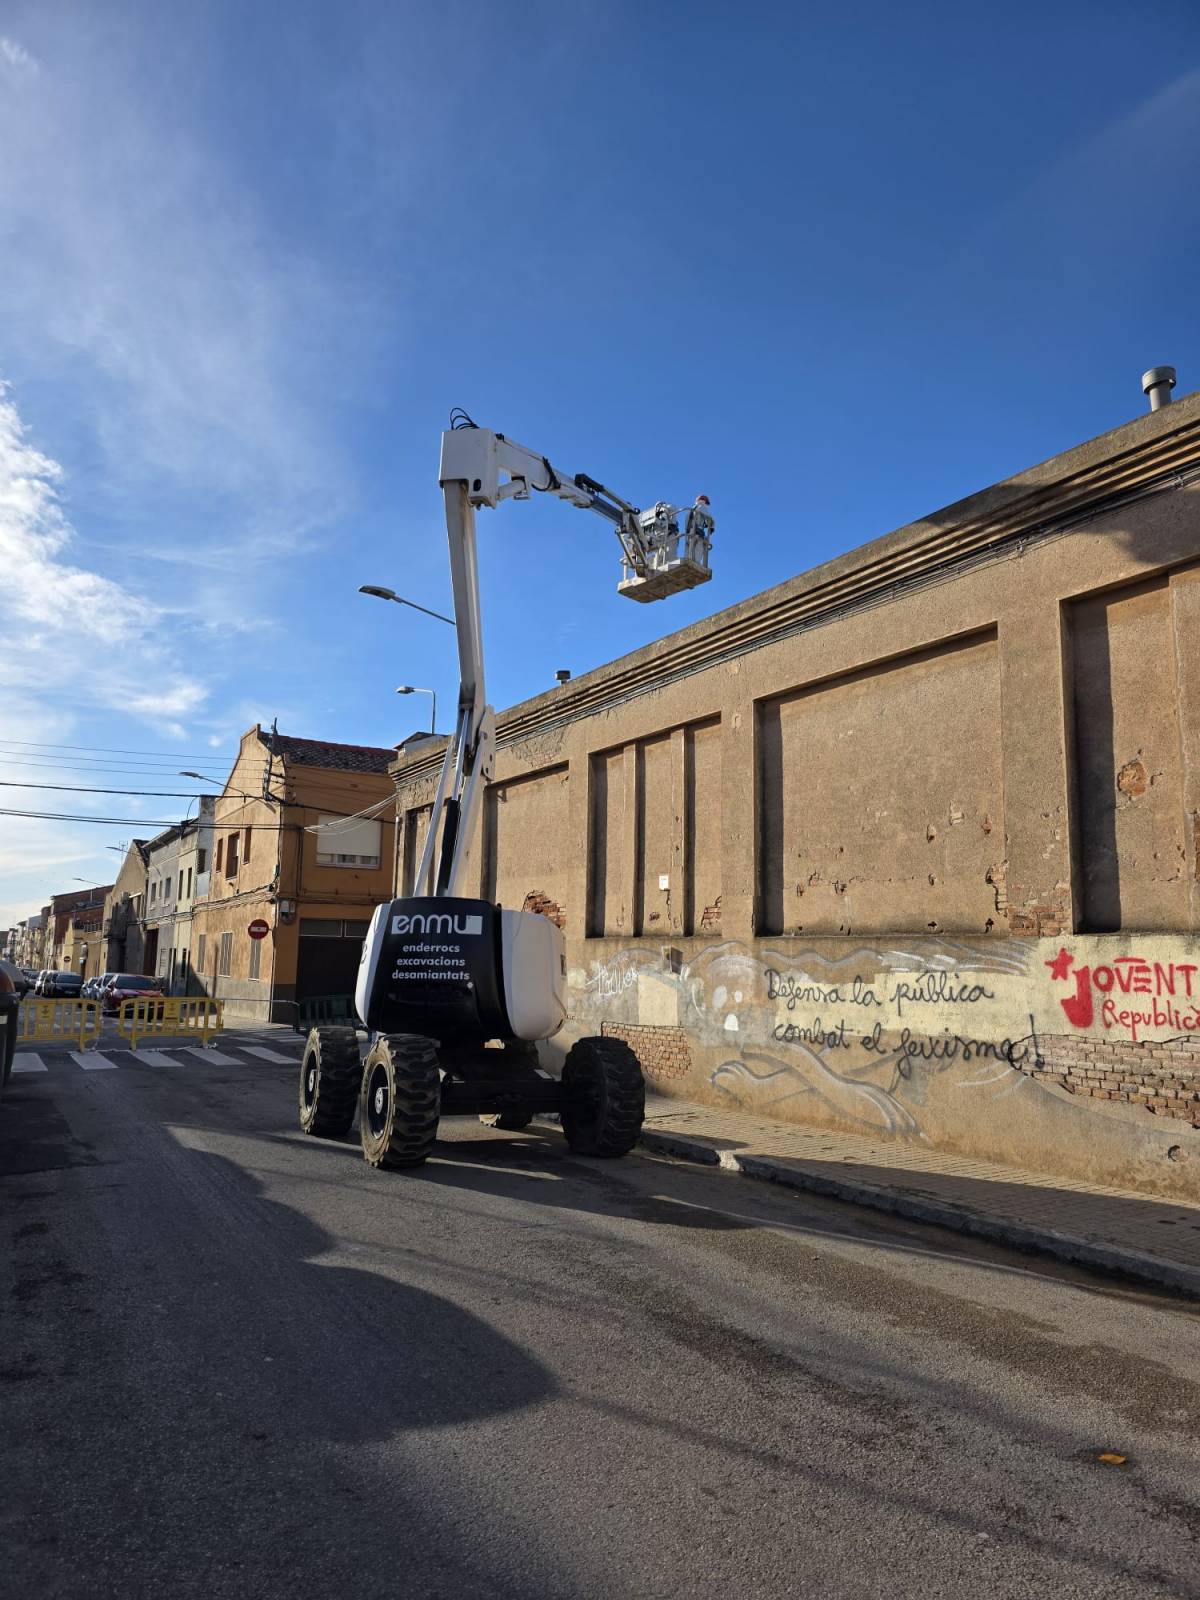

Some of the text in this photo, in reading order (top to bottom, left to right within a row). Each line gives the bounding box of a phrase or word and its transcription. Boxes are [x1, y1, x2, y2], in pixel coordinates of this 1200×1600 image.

[391, 914, 483, 935] enmu
[402, 941, 460, 953] enderrocs
[396, 955, 466, 967] excavacions
[391, 969, 471, 980] desamiantats
[764, 968, 995, 1016] Defensa la pública
[772, 1017, 854, 1049] combat
[860, 1022, 887, 1054] el
